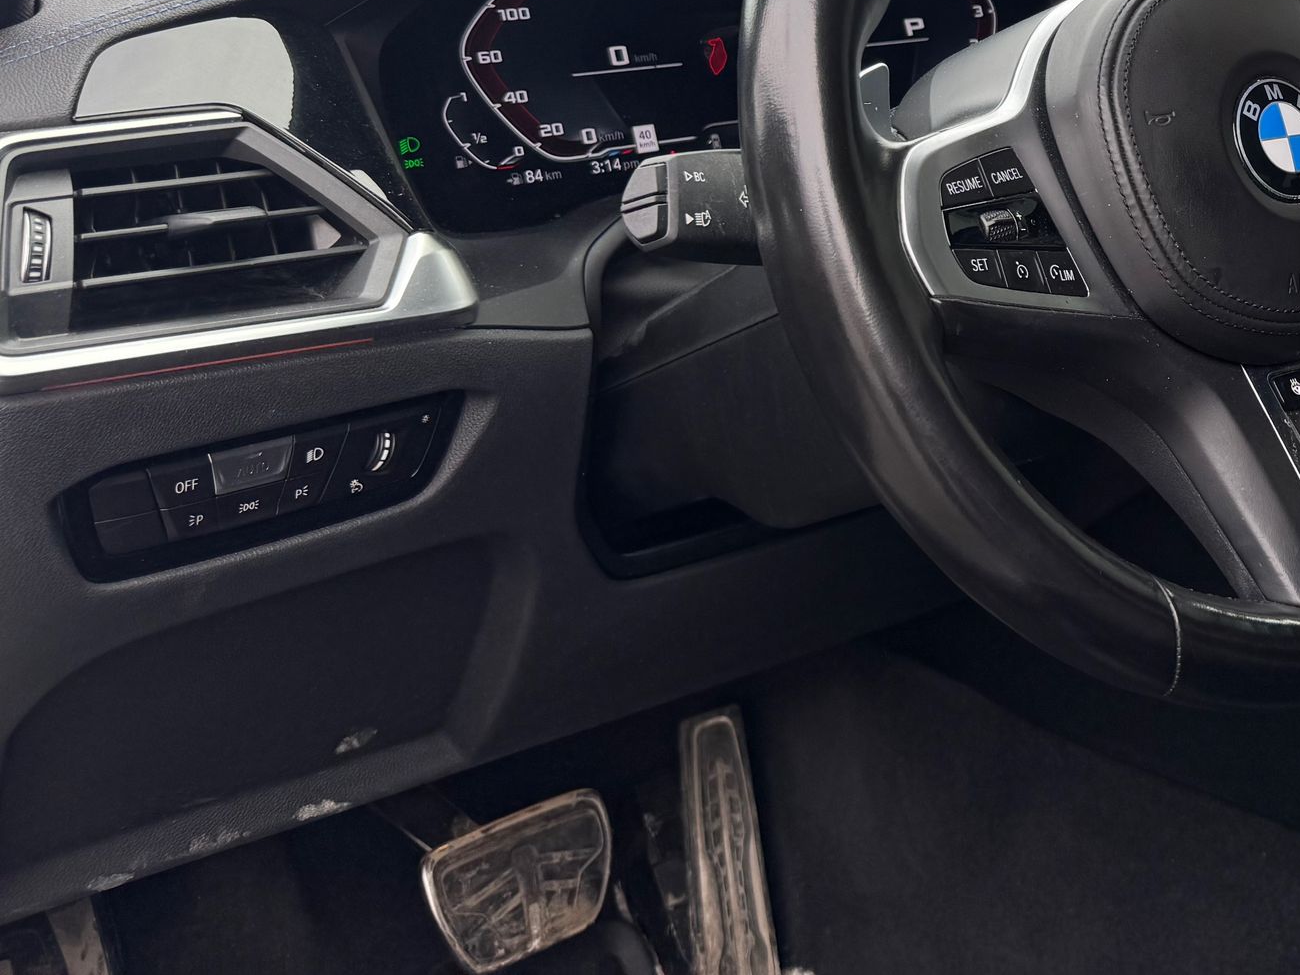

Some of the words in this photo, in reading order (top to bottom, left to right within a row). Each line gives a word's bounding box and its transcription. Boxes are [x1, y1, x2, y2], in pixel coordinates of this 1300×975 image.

[498, 7, 531, 21] 100
[972, 5, 984, 18] 3
[903, 17, 925, 37] P
[476, 50, 503, 65] 60
[607, 45, 630, 67] 0
[634, 49, 659, 63] km/h
[504, 90, 530, 104] 40
[539, 123, 564, 137] 20
[582, 128, 598, 145] 0
[598, 129, 624, 143] km/h
[639, 129, 652, 141] 40
[514, 146, 525, 157] 0
[639, 139, 656, 149] km/h
[591, 158, 622, 175] 3:14
[623, 159, 640, 171] pm
[524, 169, 544, 184] 84
[545, 169, 562, 181] km
[694, 172, 706, 183] BC
[990, 167, 1024, 185] CANCEL
[946, 175, 984, 196] RESUME
[970, 257, 988, 273] SET
[1060, 269, 1076, 281] LIM
[175, 478, 199, 494] OFF
